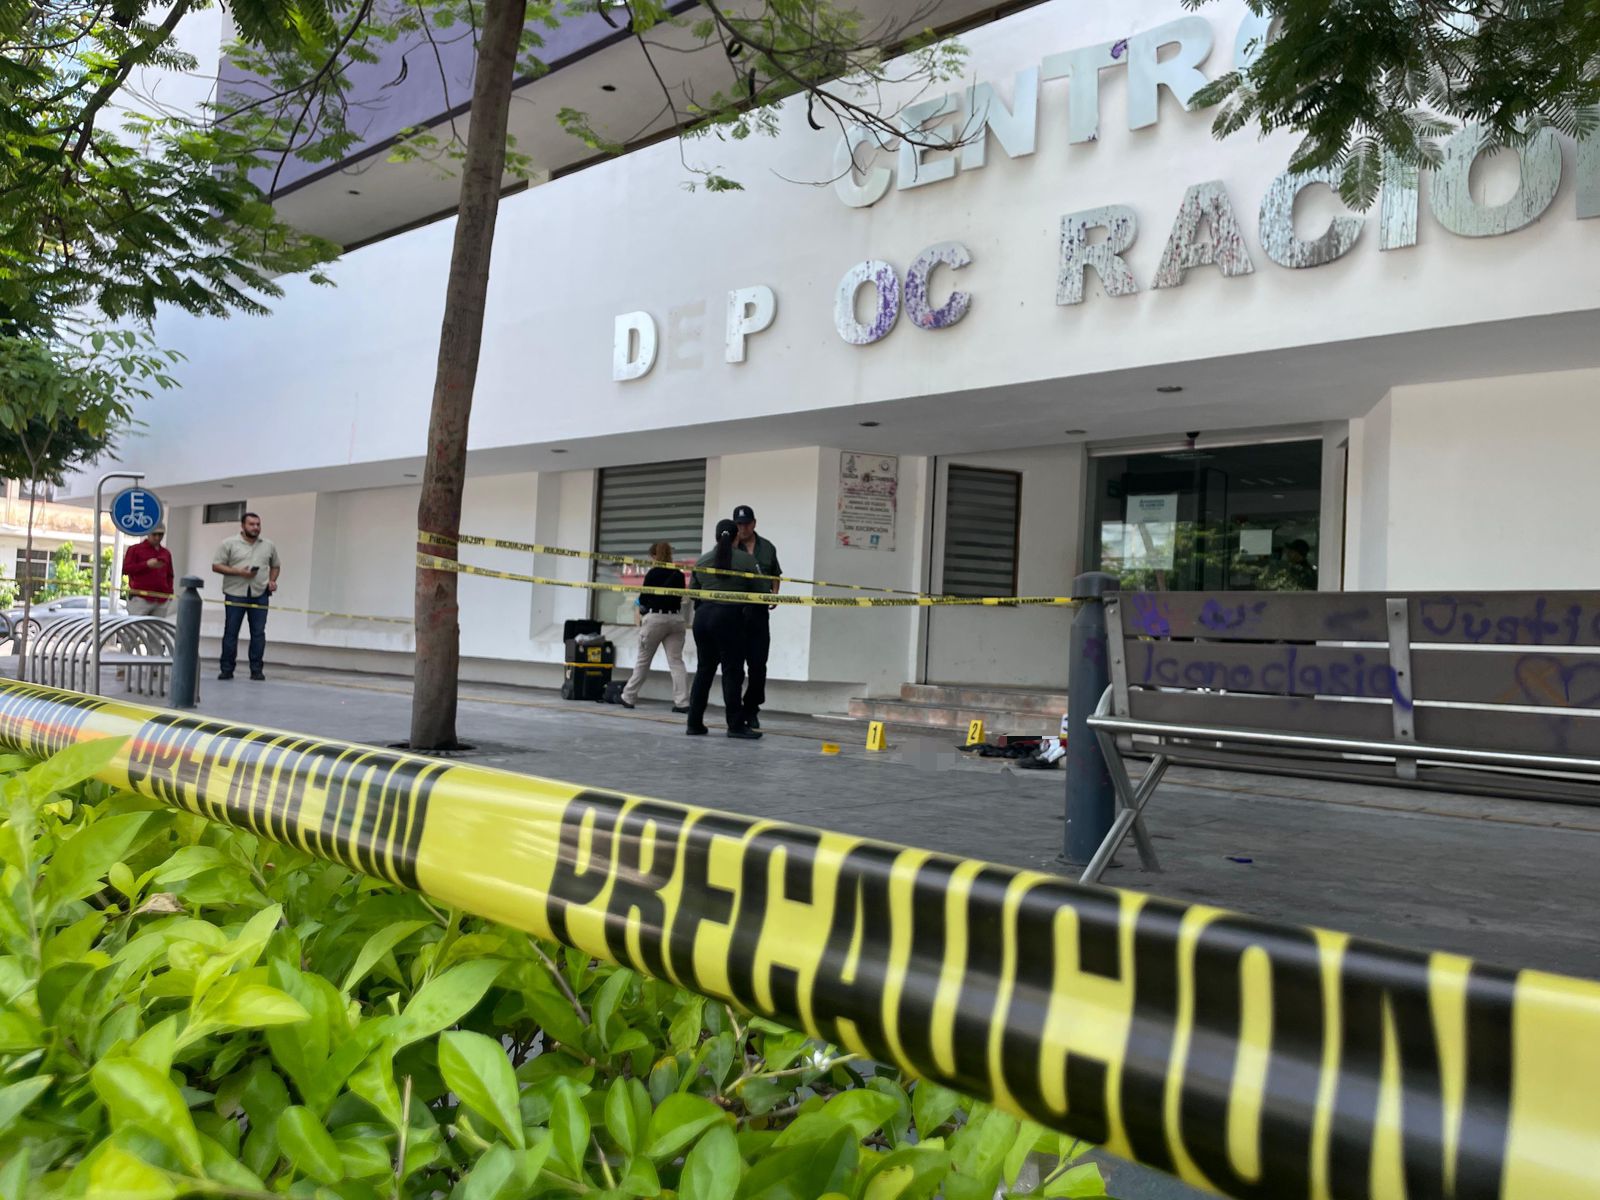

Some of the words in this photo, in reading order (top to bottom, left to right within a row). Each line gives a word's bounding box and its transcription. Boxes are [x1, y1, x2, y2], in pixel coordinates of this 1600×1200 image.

[833, 4, 1290, 209] CENTR
[1056, 112, 1600, 307] RACIO
[1420, 597, 1600, 645] Justi
